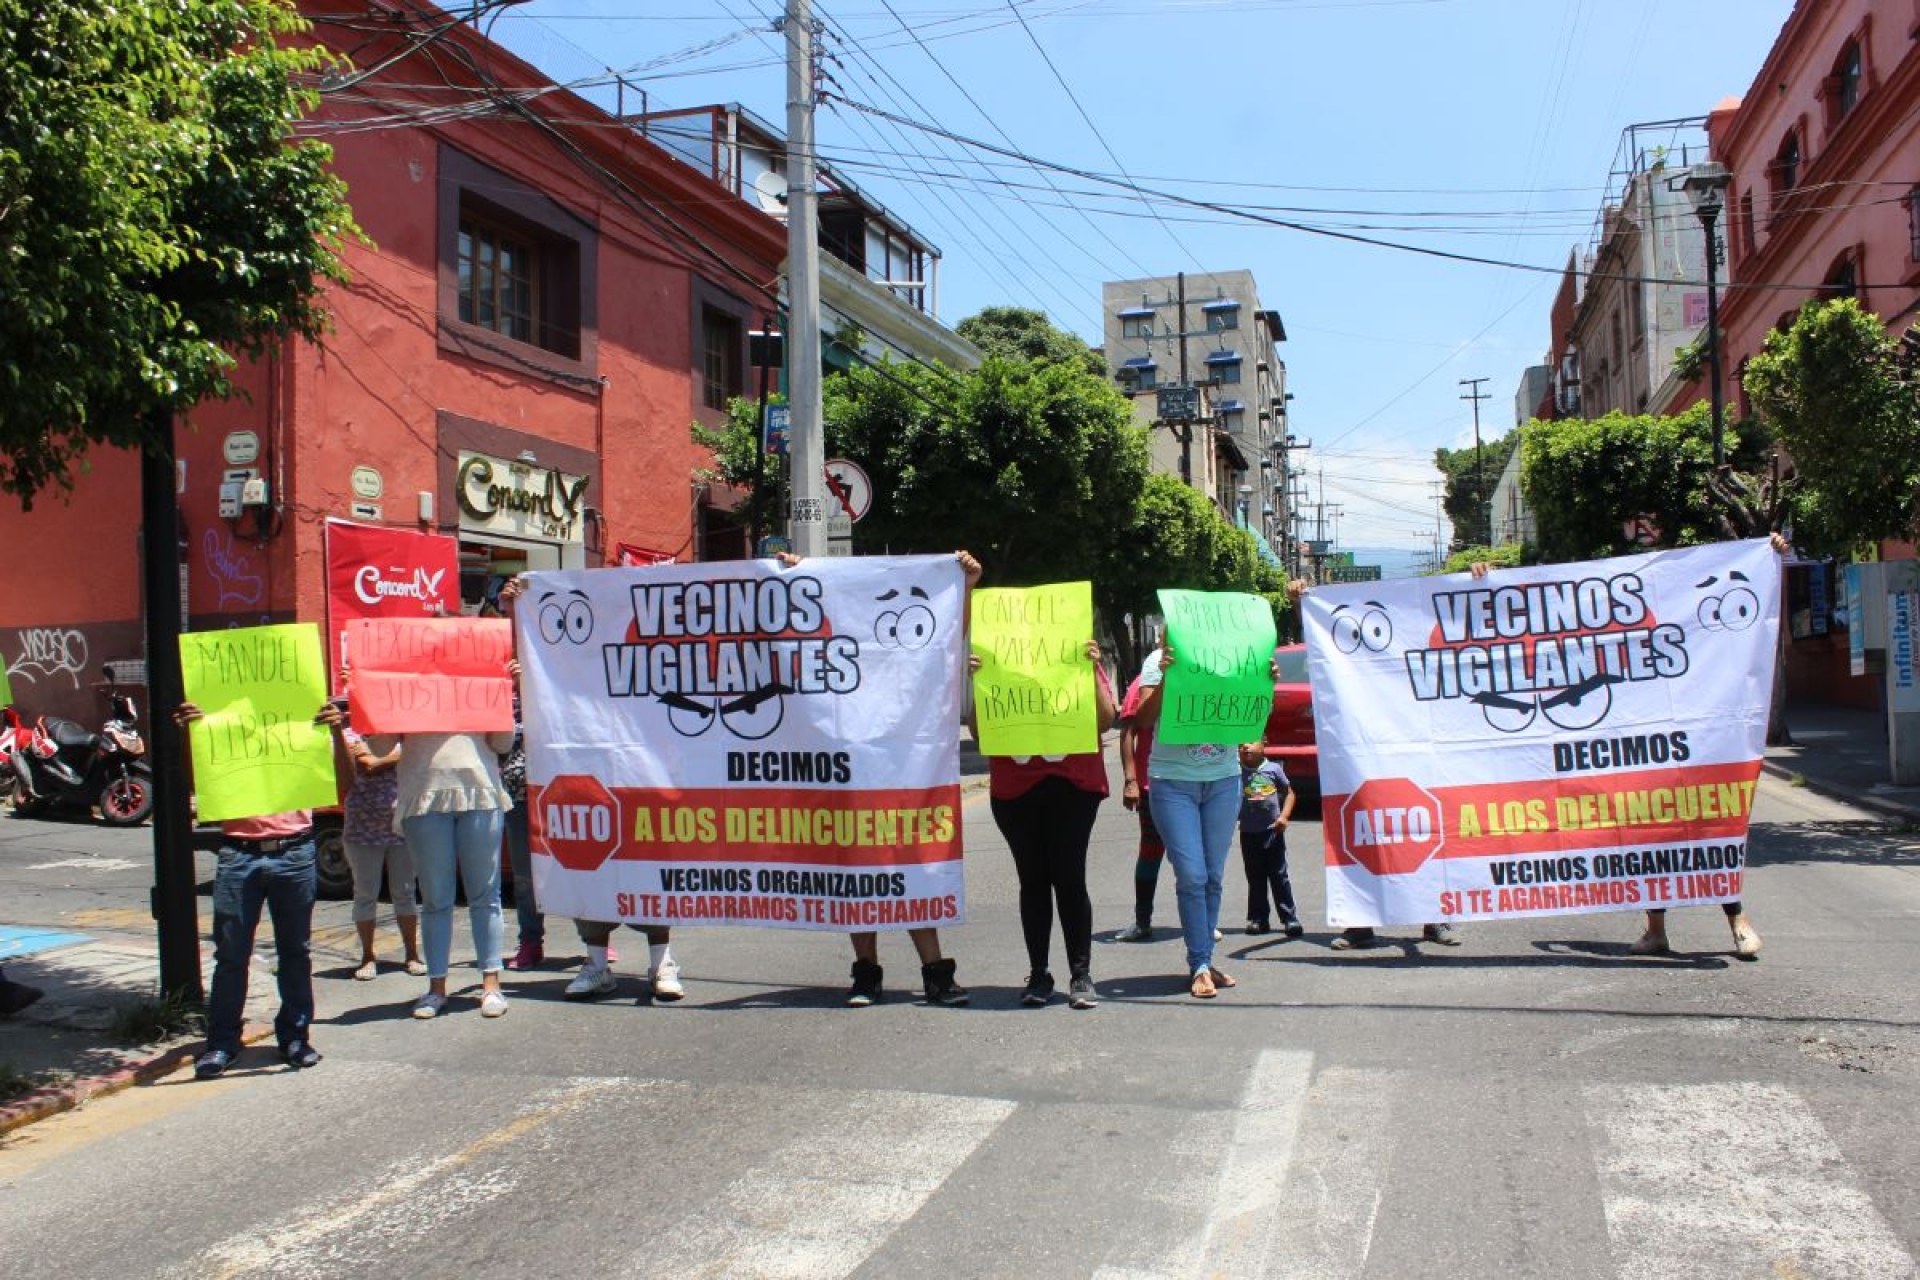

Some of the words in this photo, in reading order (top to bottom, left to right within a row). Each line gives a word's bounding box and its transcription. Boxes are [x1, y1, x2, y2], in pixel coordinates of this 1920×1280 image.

[630, 576, 825, 638] VECINOS
[1432, 572, 1648, 645] VECINOS
[993, 635, 1050, 667] PARA
[1060, 638, 1081, 665] EL
[1893, 590, 1913, 688] infinitum
[198, 634, 307, 688] MANUEL
[602, 635, 861, 697] VIGILANTES
[1188, 644, 1259, 677] JUSTA
[1405, 622, 1689, 701] VIGILANTES
[381, 677, 510, 713] JUSTICIA
[1177, 693, 1269, 723] LIBERTAD
[208, 711, 309, 765] LIBRE
[1553, 731, 1691, 773] DECIMOS
[727, 751, 851, 783] DECIMOS
[546, 805, 610, 841] ALTO
[634, 807, 658, 844] A
[661, 806, 717, 844] LOS
[726, 805, 955, 848] DELINCUENTES
[1353, 806, 1431, 847] ALTO
[1458, 804, 1481, 839] A
[1487, 798, 1550, 837] LOS
[660, 868, 752, 893] VECINOS
[757, 869, 906, 898] ORGANIZADOS
[1489, 857, 1588, 886] VECINOS
[617, 893, 636, 916] SI
[640, 893, 661, 917] TE
[665, 893, 799, 922] AGARRAMOS
[803, 897, 825, 924] TE
[829, 893, 957, 925] LINCHAMOS
[1440, 892, 1463, 916] SI
[1467, 889, 1494, 915] TE
[1498, 880, 1641, 913] AGARRAMOS
[1645, 877, 1673, 901] TE
